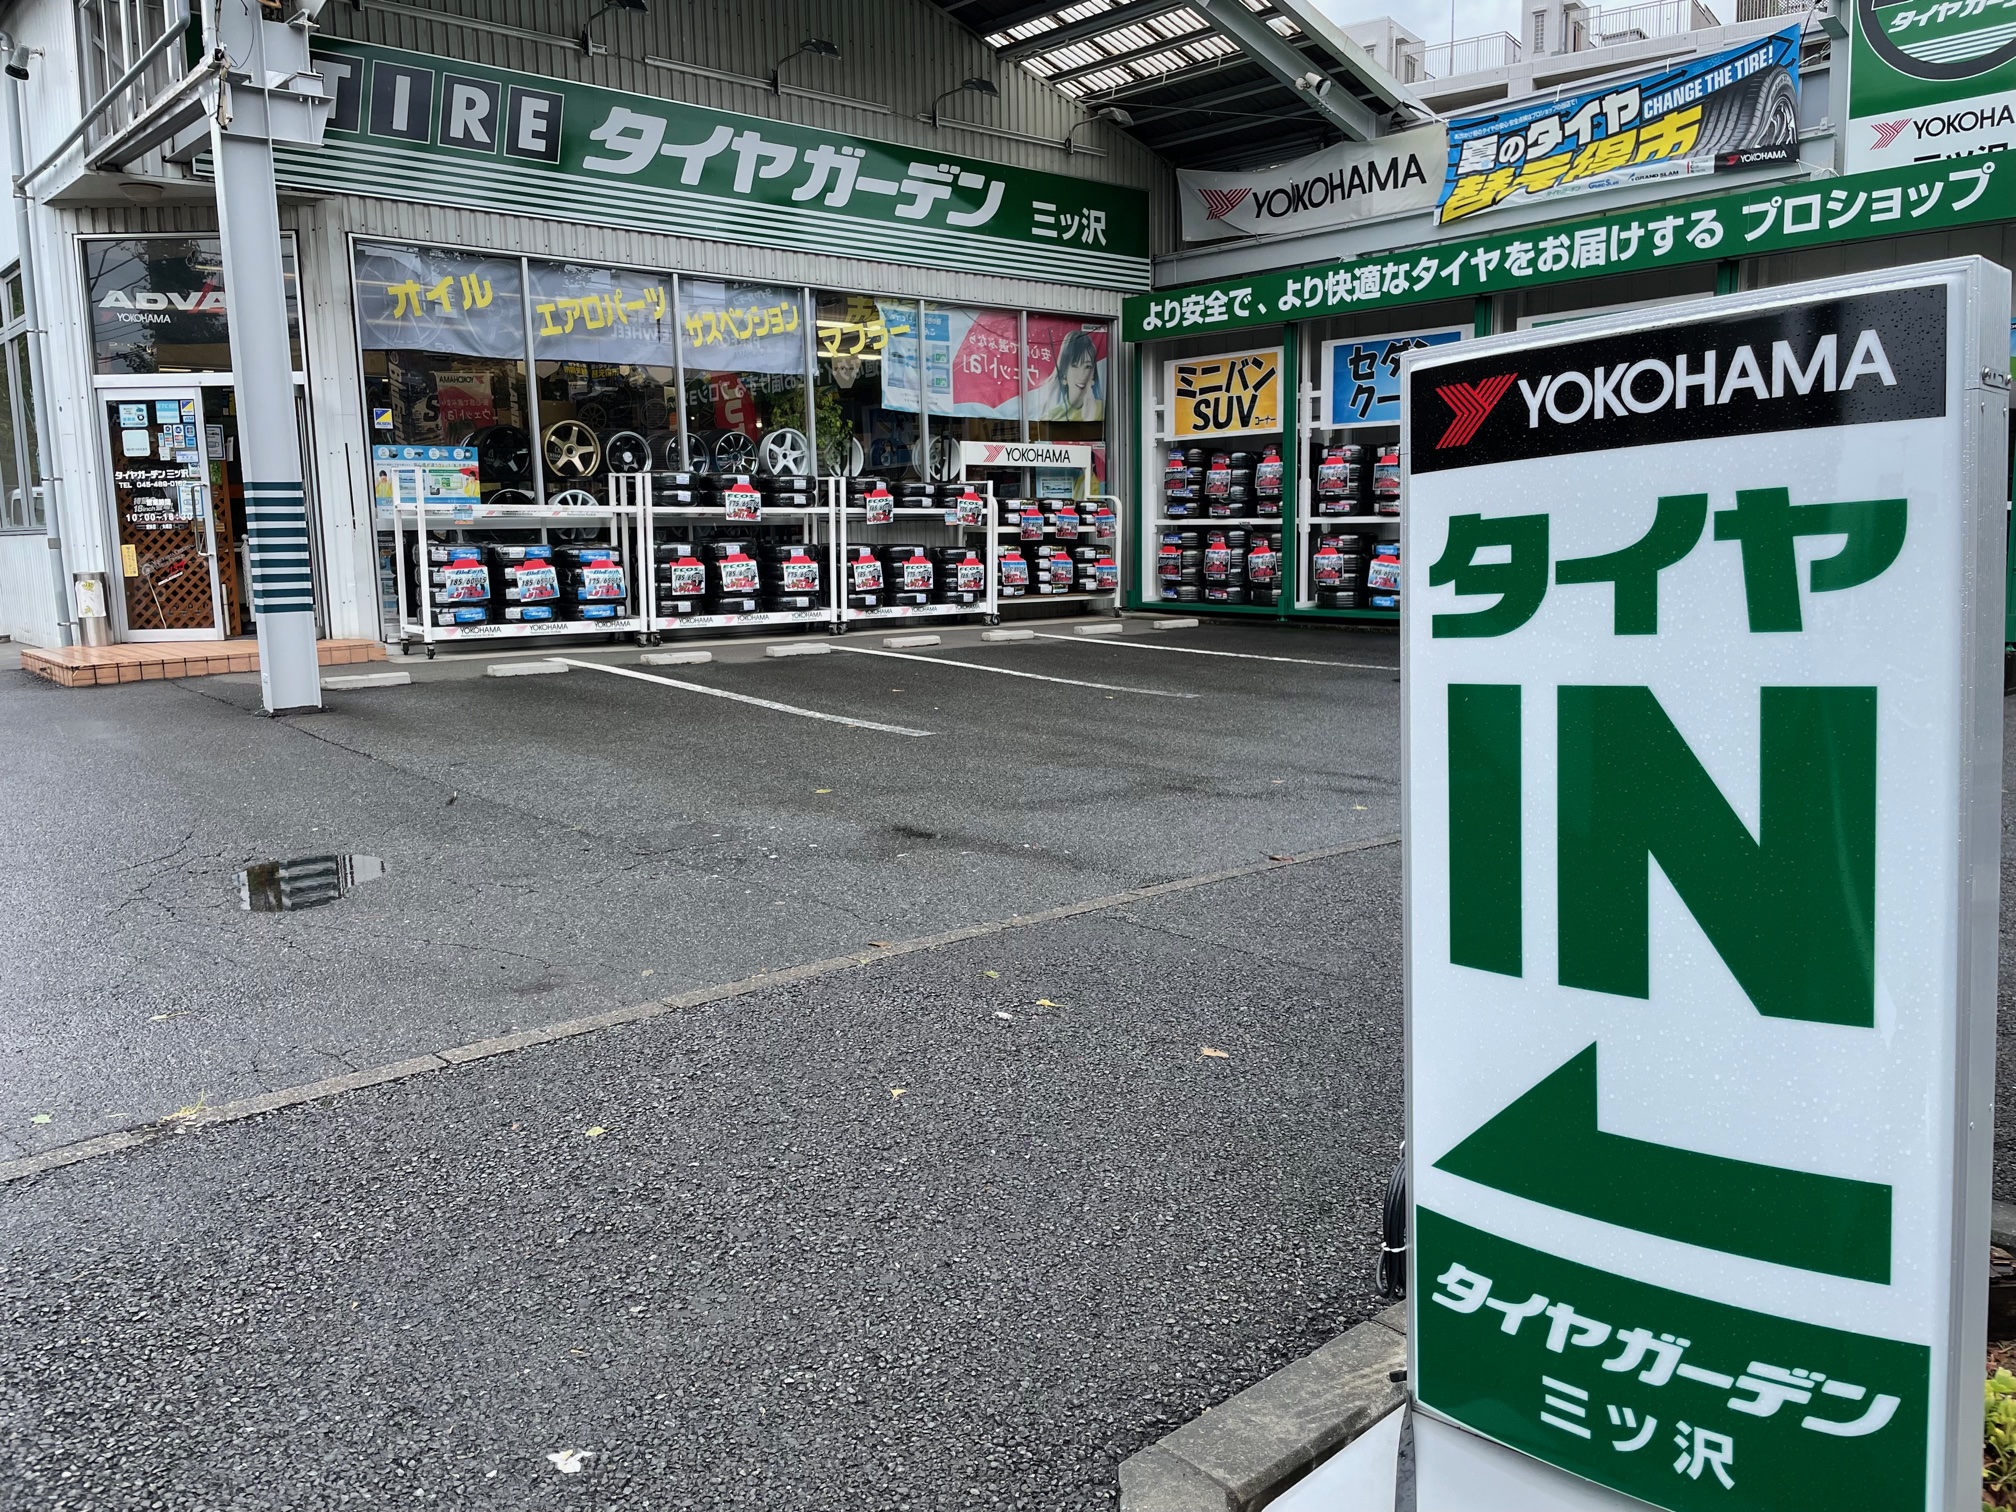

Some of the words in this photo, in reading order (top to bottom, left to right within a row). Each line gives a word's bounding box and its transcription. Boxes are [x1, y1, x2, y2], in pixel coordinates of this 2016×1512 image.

[1643, 78, 1703, 120] CHANGE
[1705, 66, 1733, 92] THE
[1735, 45, 1774, 80] TIRE!
[312, 59, 550, 152] TIRE
[1913, 104, 2016, 140] YOKOHA
[1456, 86, 1640, 175] 夏のタイヤ
[583, 106, 1005, 228] タイヤガーデン
[1634, 173, 1659, 182] GRAND
[1660, 170, 1679, 178] SLAM
[1740, 150, 1788, 163] YOKOHAMA
[1252, 153, 1427, 219] YOKOHAMA
[1742, 161, 1996, 242] プロショップ
[98, 289, 227, 312] ADVA
[387, 273, 494, 319] オイル
[535, 286, 666, 337] エアロパーツ
[116, 312, 171, 324] YOKOHAMA
[685, 301, 799, 348] サスペンション
[817, 319, 911, 357] マフラー
[1176, 356, 1277, 399] ミニバン
[1517, 329, 1897, 429] YOKOHAMA
[1191, 393, 1259, 432] SUV
[1254, 414, 1277, 426] コーナー
[1349, 383, 1401, 420] クー
[115, 469, 166, 480] タイヤガーデン
[1005, 447, 1071, 464] YOKOHAMA
[1429, 486, 1908, 640] タイヤ
[461, 626, 501, 635] YOKOHAMA
[529, 623, 568, 631] YOKOHAMA
[594, 620, 631, 628] YOKOHAMA
[679, 616, 714, 624] YOKOHAMA
[1447, 683, 1878, 1029] IN
[1431, 1262, 1901, 1437] タイヤガーデン
